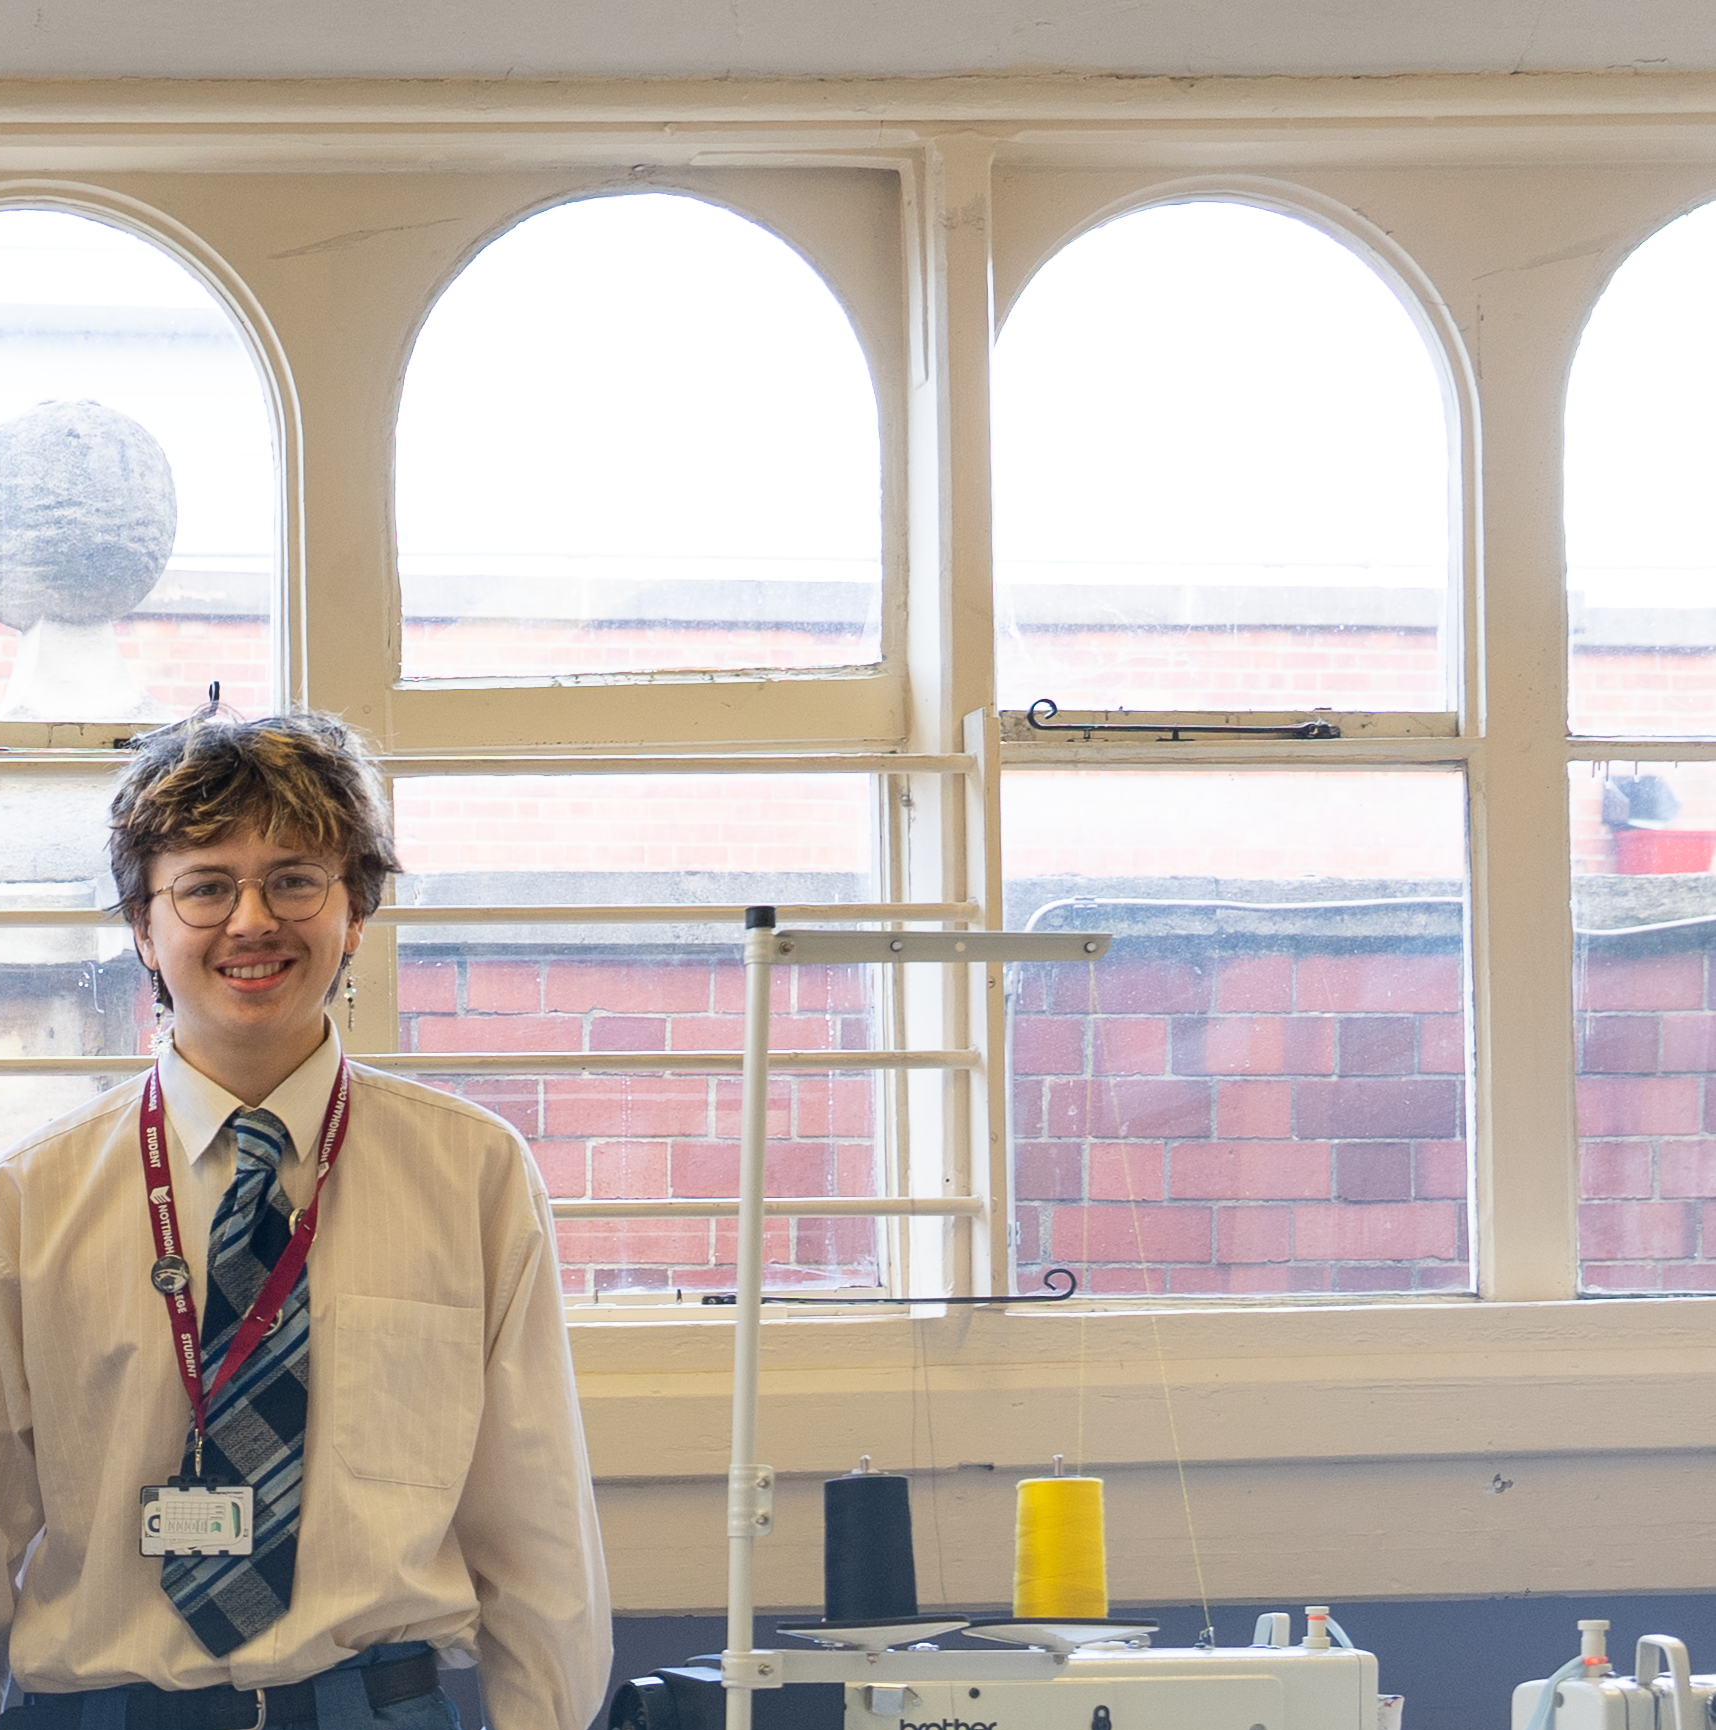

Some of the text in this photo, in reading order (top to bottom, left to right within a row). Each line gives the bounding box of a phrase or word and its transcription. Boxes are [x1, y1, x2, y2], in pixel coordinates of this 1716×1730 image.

[146, 1126, 162, 1169] STUDENT
[320, 1101, 346, 1162] NOTTINGHAM
[158, 1204, 188, 1314] NOTTINGH LEGE
[180, 1333, 197, 1379] STUDENT
